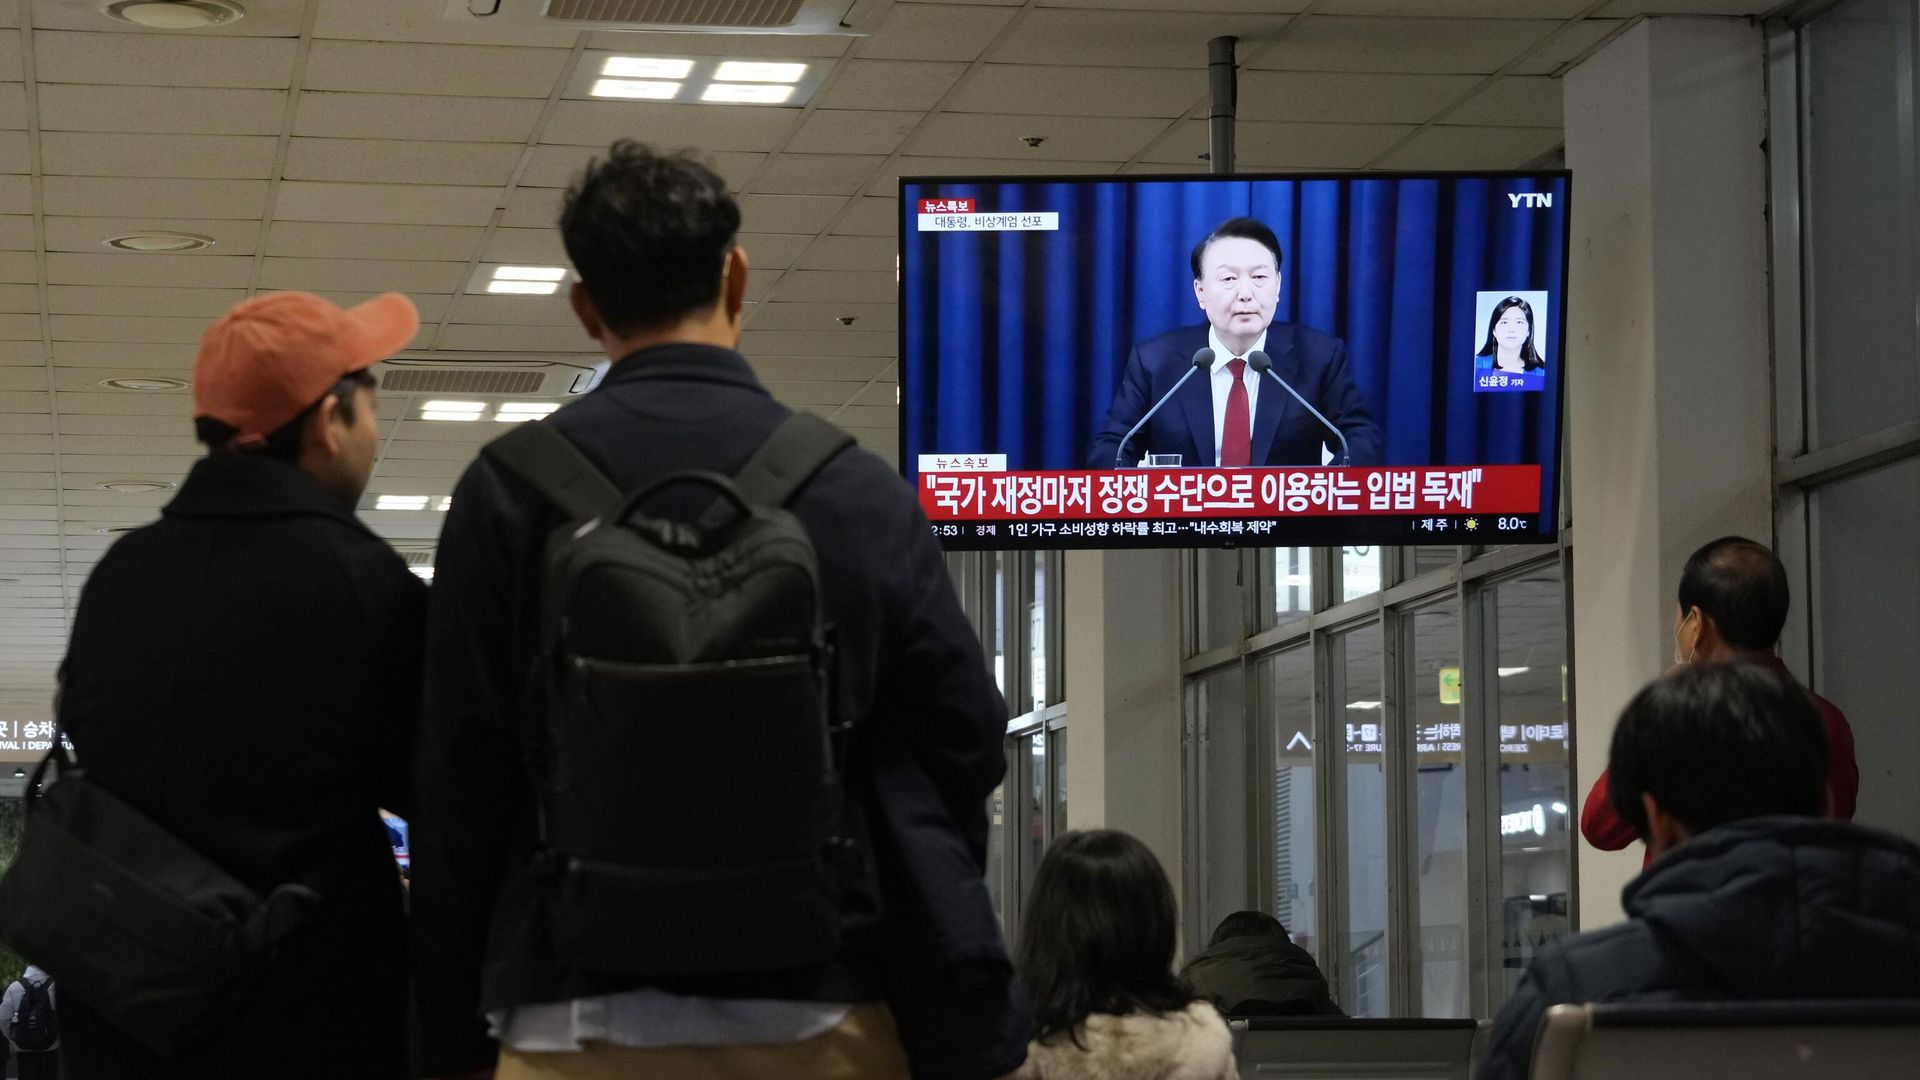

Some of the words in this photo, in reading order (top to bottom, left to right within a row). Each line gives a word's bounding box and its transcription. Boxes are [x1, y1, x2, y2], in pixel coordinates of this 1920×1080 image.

[925, 200, 969, 213] 뉴스특보
[1508, 193, 1553, 208] YTN
[935, 216, 971, 228] 대통령,
[975, 216, 1018, 228] 비상계엄
[1021, 216, 1043, 228] 선포
[1479, 376, 1508, 388] 신윤정
[1511, 378, 1524, 387] 기자
[935, 456, 989, 469] 뉴스속보
[926, 474, 987, 515] "국가
[991, 474, 1092, 514] 재정마저
[1098, 474, 1149, 514] 정쟁
[1153, 472, 1255, 513] 수단으로
[1261, 471, 1361, 512] 이용하는
[1367, 470, 1416, 511] 입법
[1421, 468, 1482, 510] 독재"
[976, 525, 996, 536] 경제
[1008, 523, 1028, 537] 1인
[1031, 523, 1057, 537] 가구
[1059, 522, 1110, 536] 소비성향
[1112, 521, 1149, 536] 하락률
[1246, 520, 1277, 534] 제약"
[1420, 518, 1448, 531] 제주
